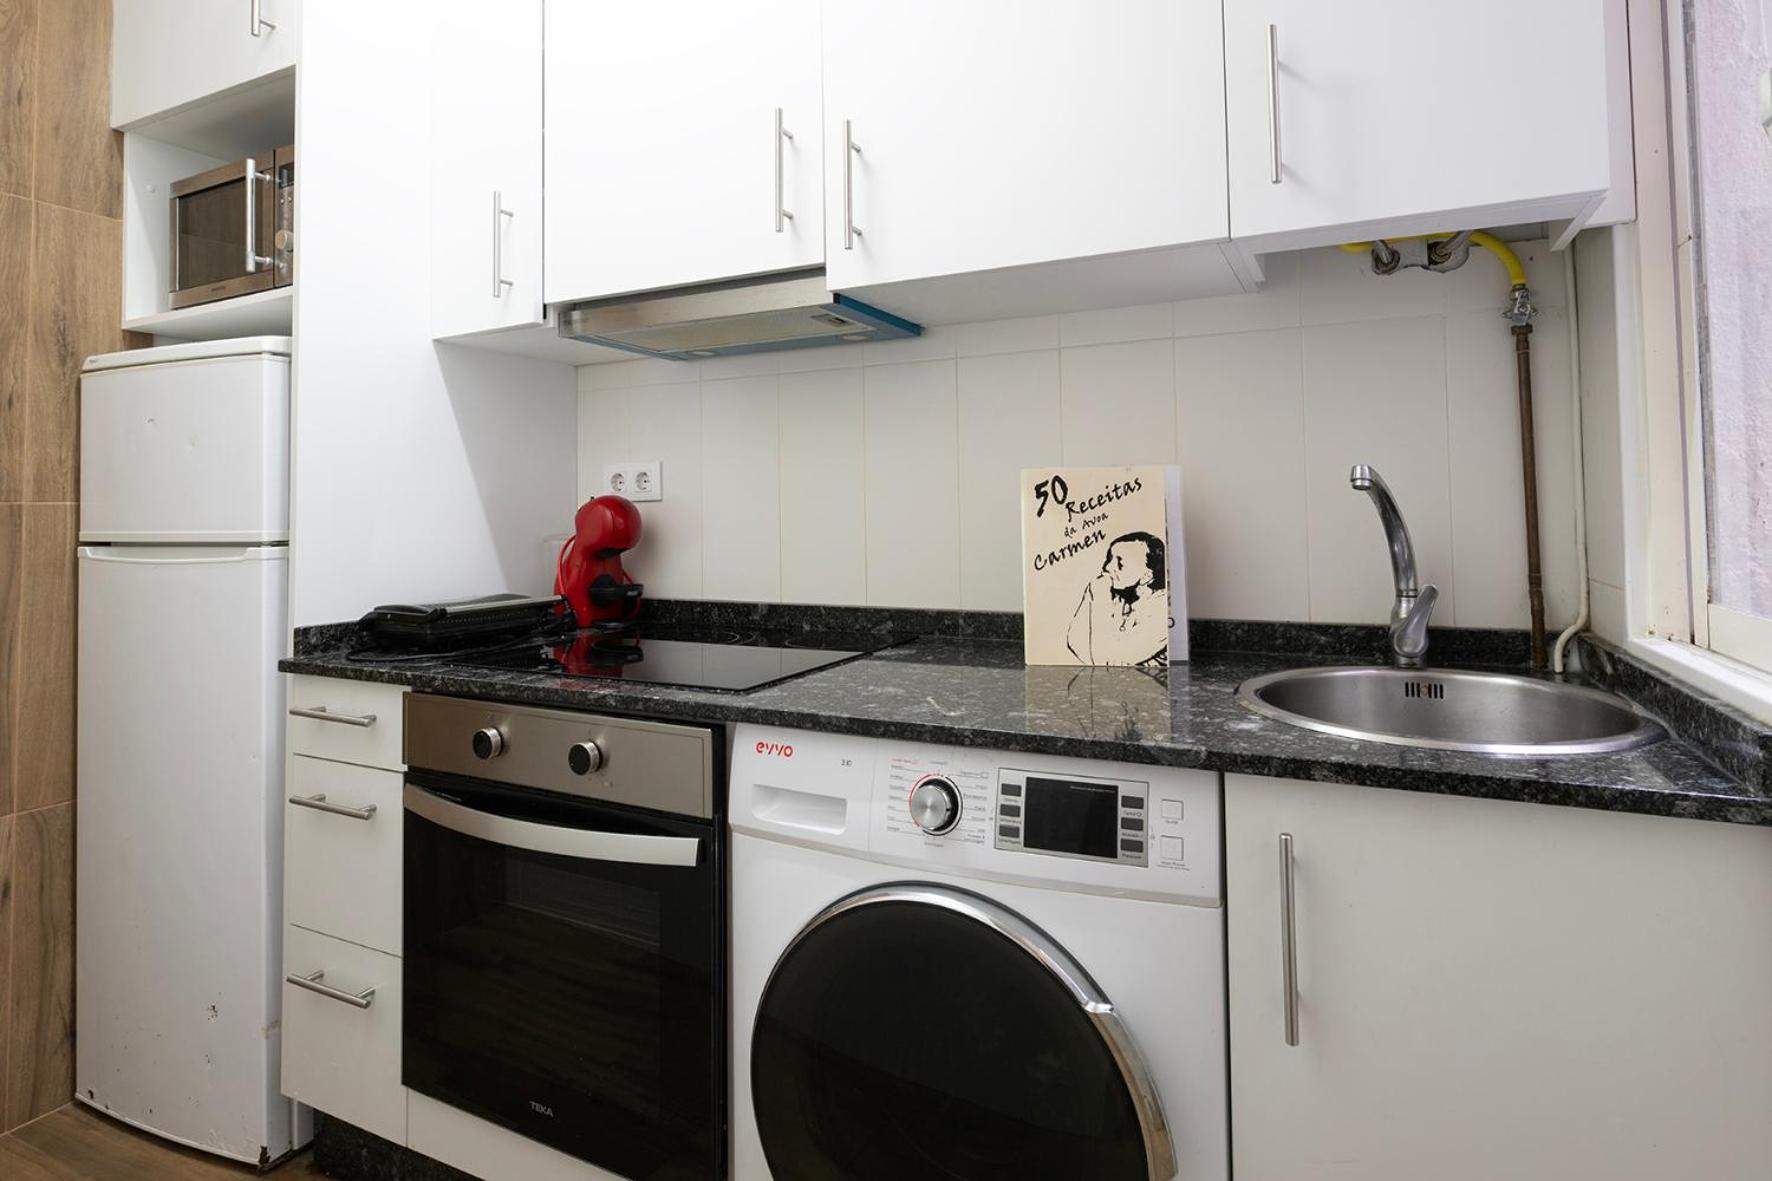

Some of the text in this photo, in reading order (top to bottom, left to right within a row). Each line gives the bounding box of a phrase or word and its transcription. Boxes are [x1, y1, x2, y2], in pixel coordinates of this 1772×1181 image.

[1034, 475, 1142, 522] 50 Receitas
[1064, 526, 1077, 539] da
[1034, 529, 1106, 571] Carmen
[529, 1100, 555, 1118] TEKA
